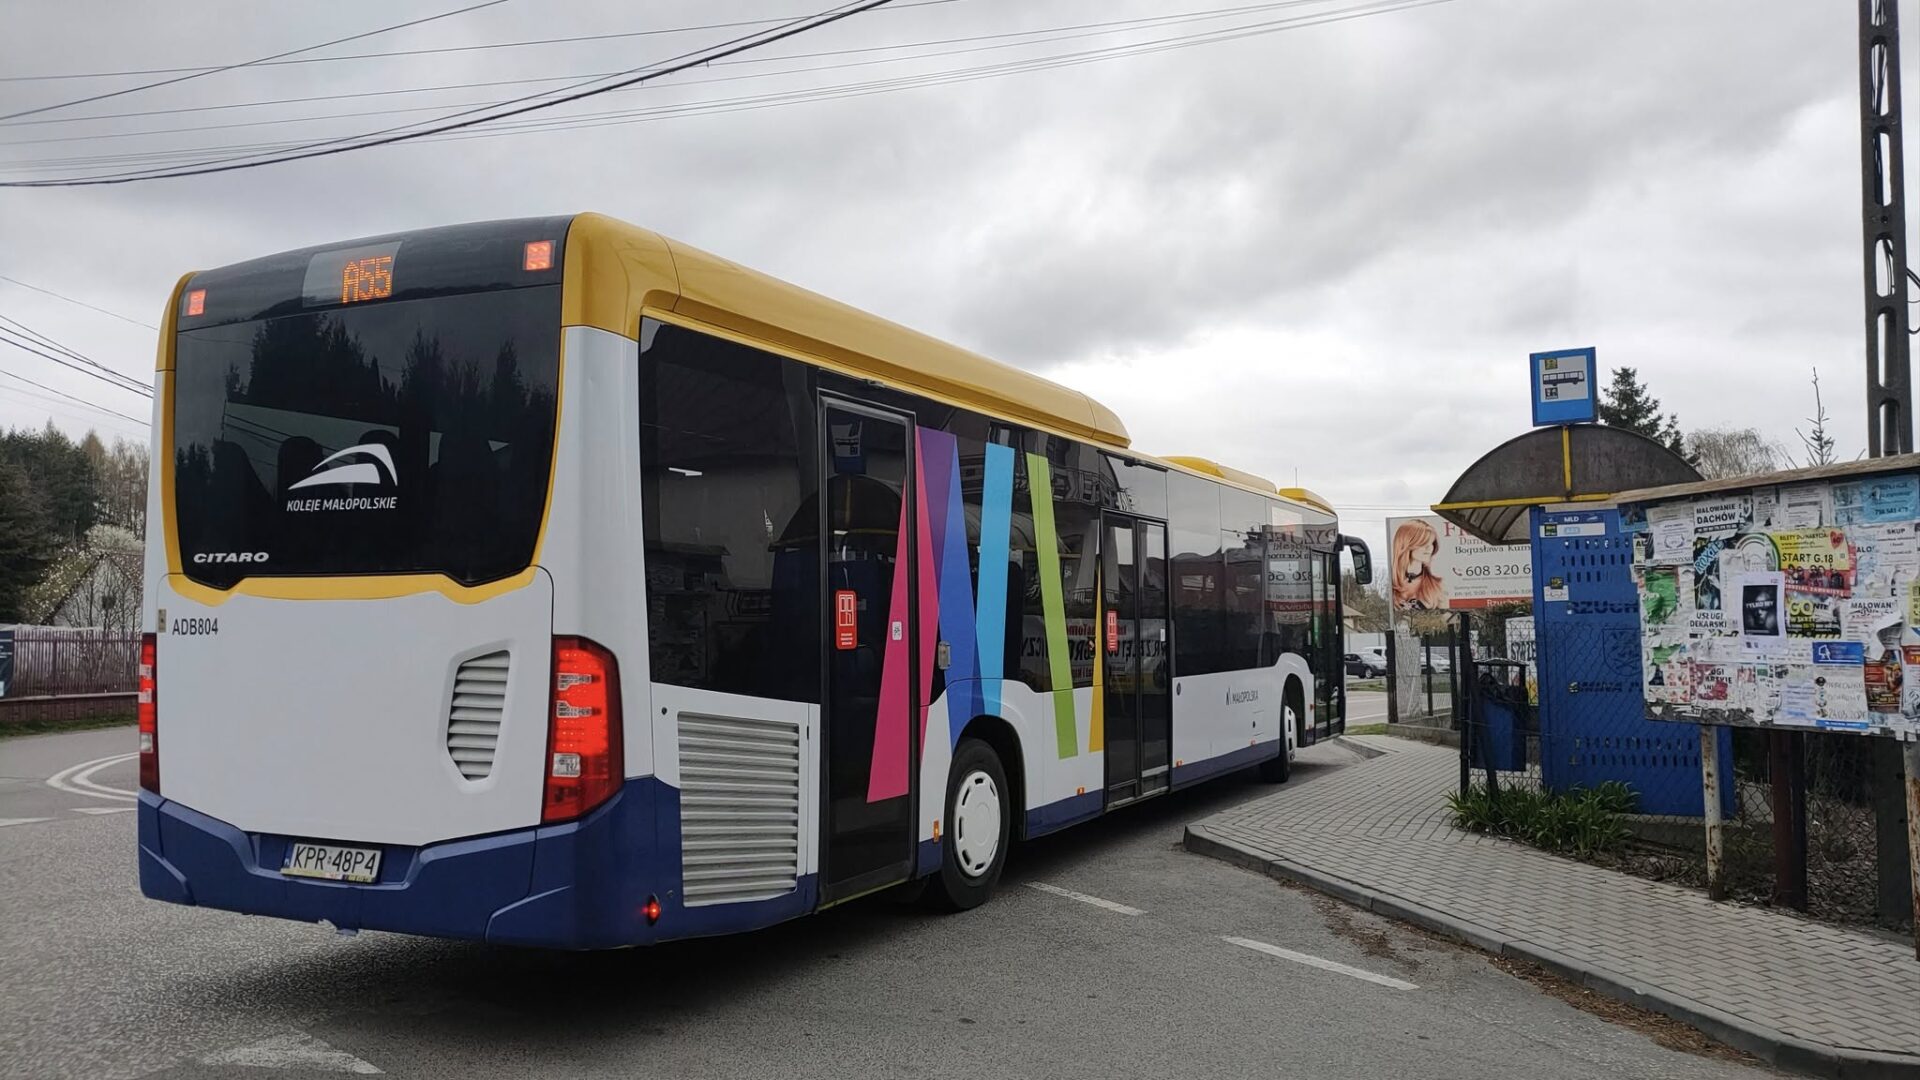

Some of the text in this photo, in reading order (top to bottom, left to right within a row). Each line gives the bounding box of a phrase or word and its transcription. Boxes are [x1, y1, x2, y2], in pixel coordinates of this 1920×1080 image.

[342, 256, 392, 303] A55
[286, 497, 398, 512] KOLEJE MAŁOPOLSKIE
[1696, 503, 1736, 514] MALOWANIE
[1696, 512, 1736, 524] DACHÓW
[193, 552, 269, 563] CITARO
[1782, 552, 1811, 562] START
[1465, 565, 1491, 577] 608
[1494, 564, 1519, 576] 320
[172, 618, 219, 635] ADB804
[293, 845, 377, 875] KPR 48P4
